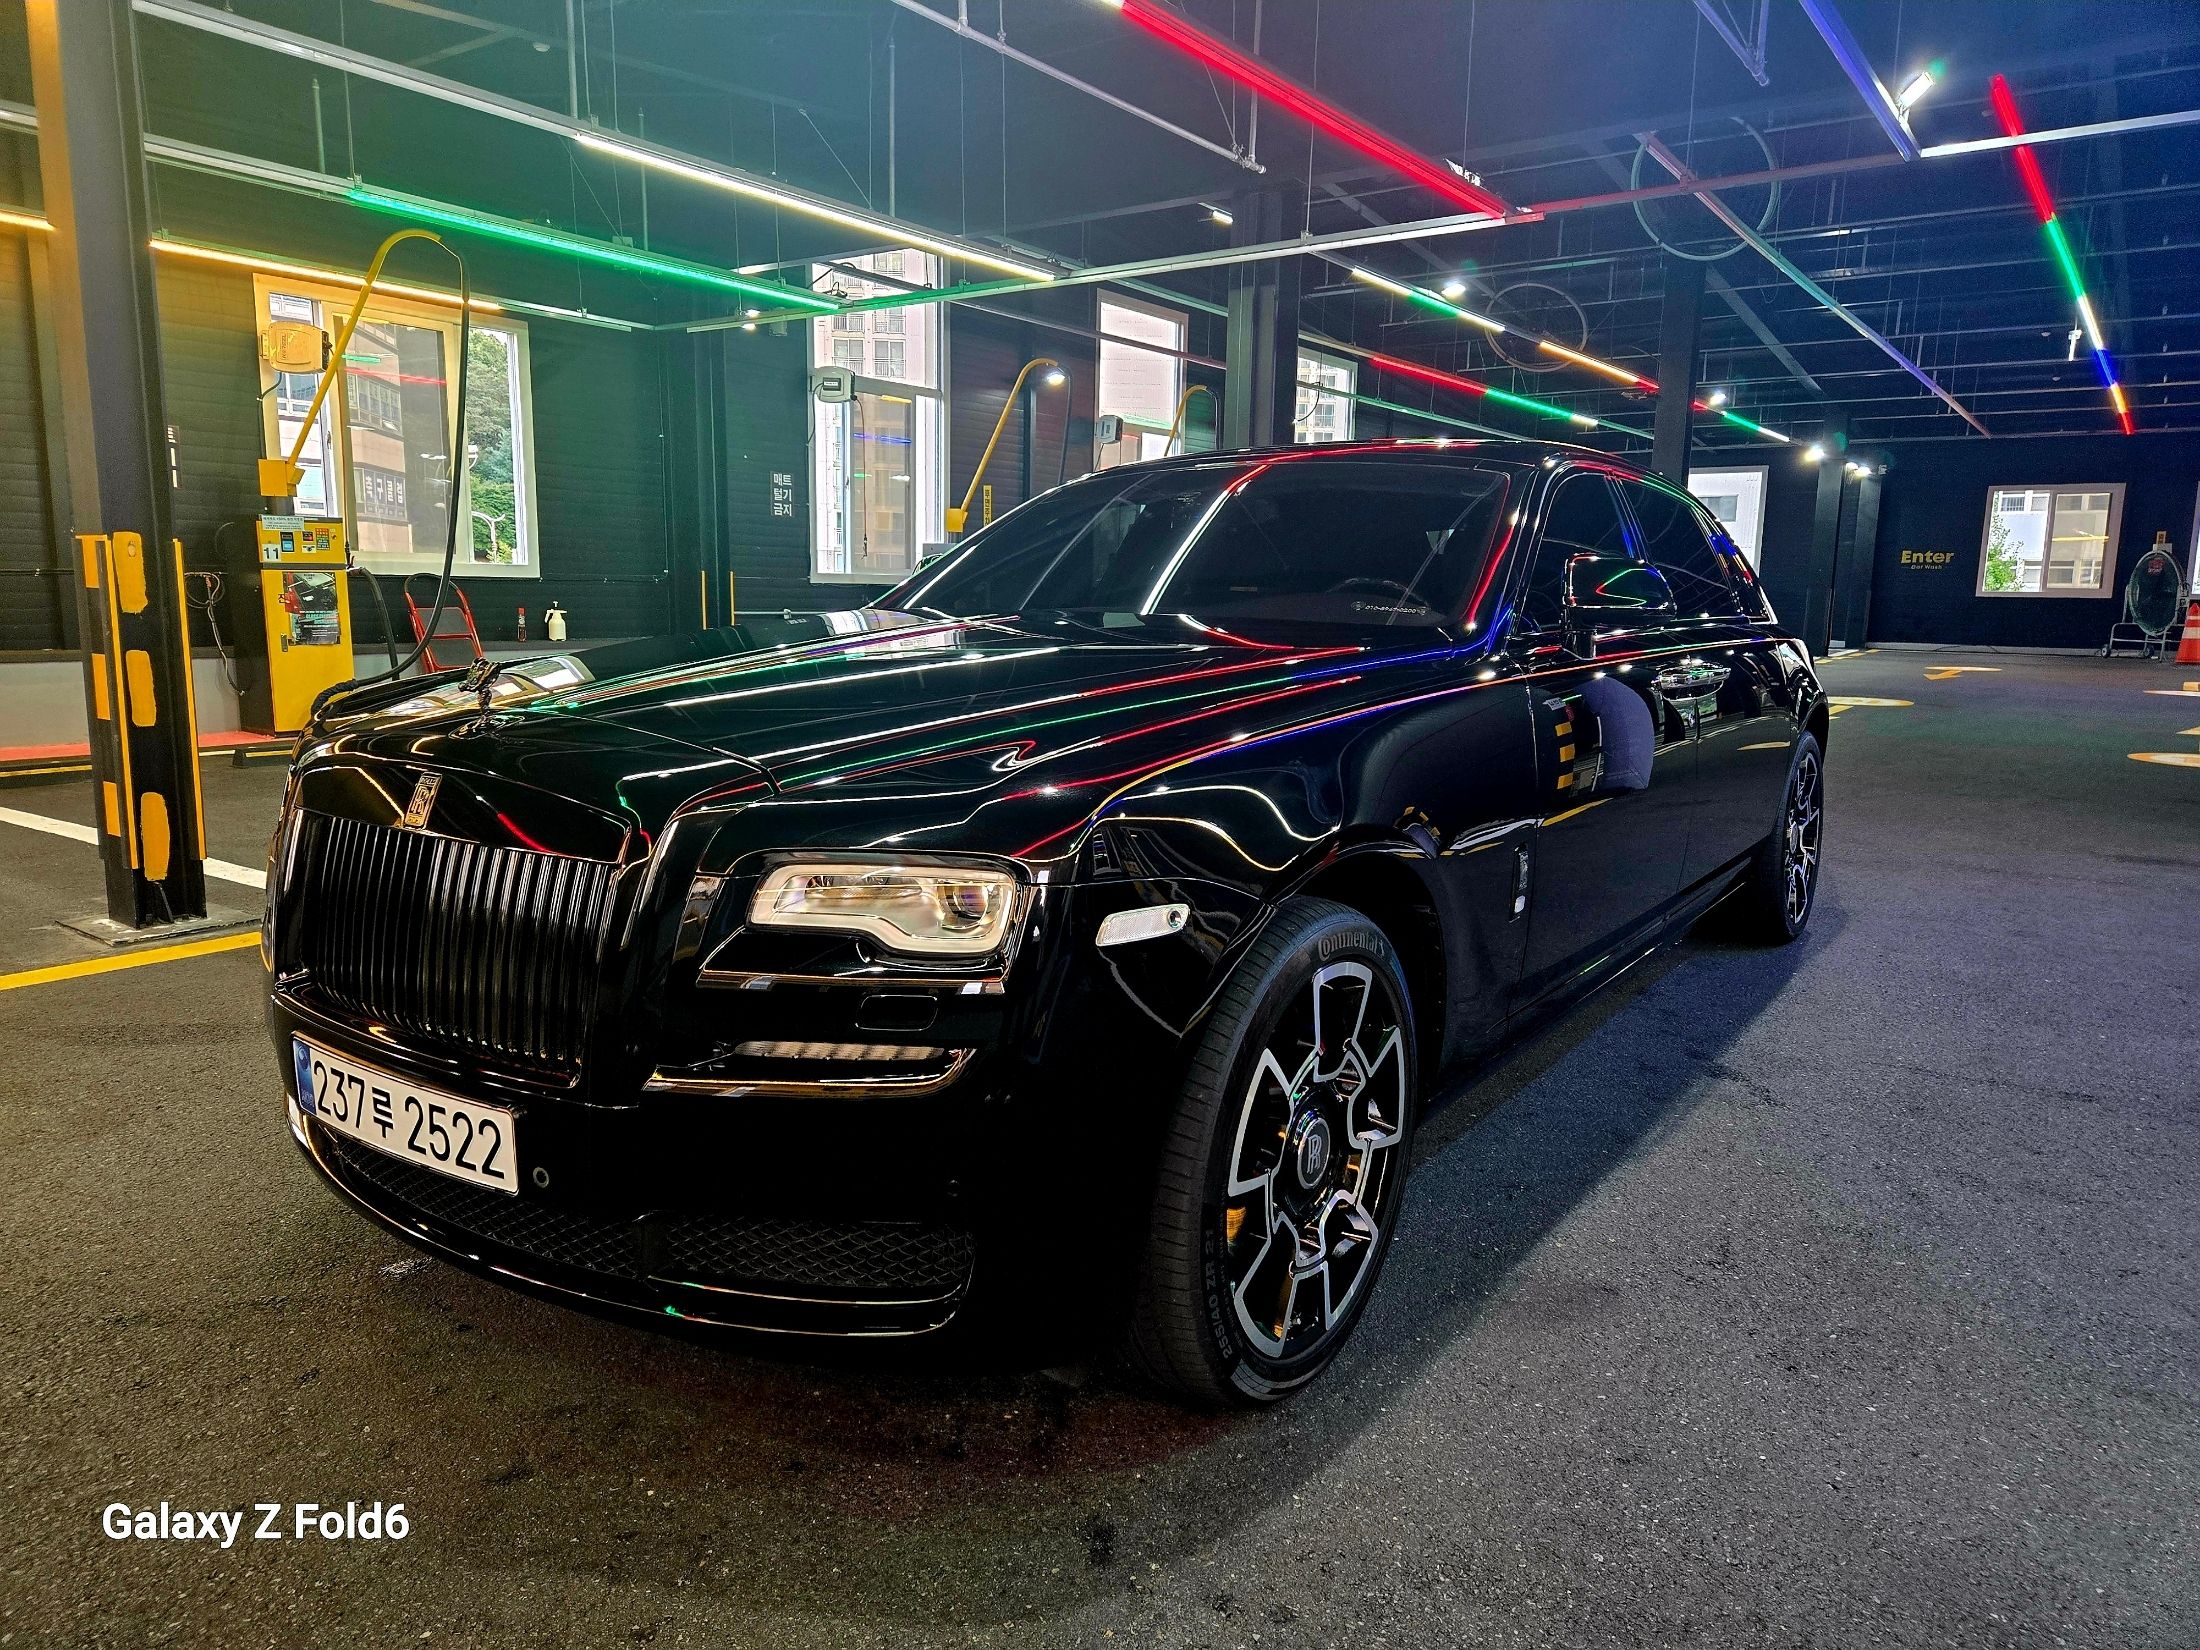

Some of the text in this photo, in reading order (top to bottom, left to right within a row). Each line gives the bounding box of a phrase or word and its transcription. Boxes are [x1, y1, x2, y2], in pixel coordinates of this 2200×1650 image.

[773, 473, 792, 486] 매트
[773, 487, 792, 502] 털기
[773, 502, 792, 517] 금지
[263, 547, 279, 560] 11
[1900, 550, 1955, 564] Enter
[1317, 931, 1378, 962] Continental
[313, 1060, 505, 1180] 237루 2522
[1204, 1228, 1215, 1255] 21
[1205, 1262, 1217, 1291] ZR
